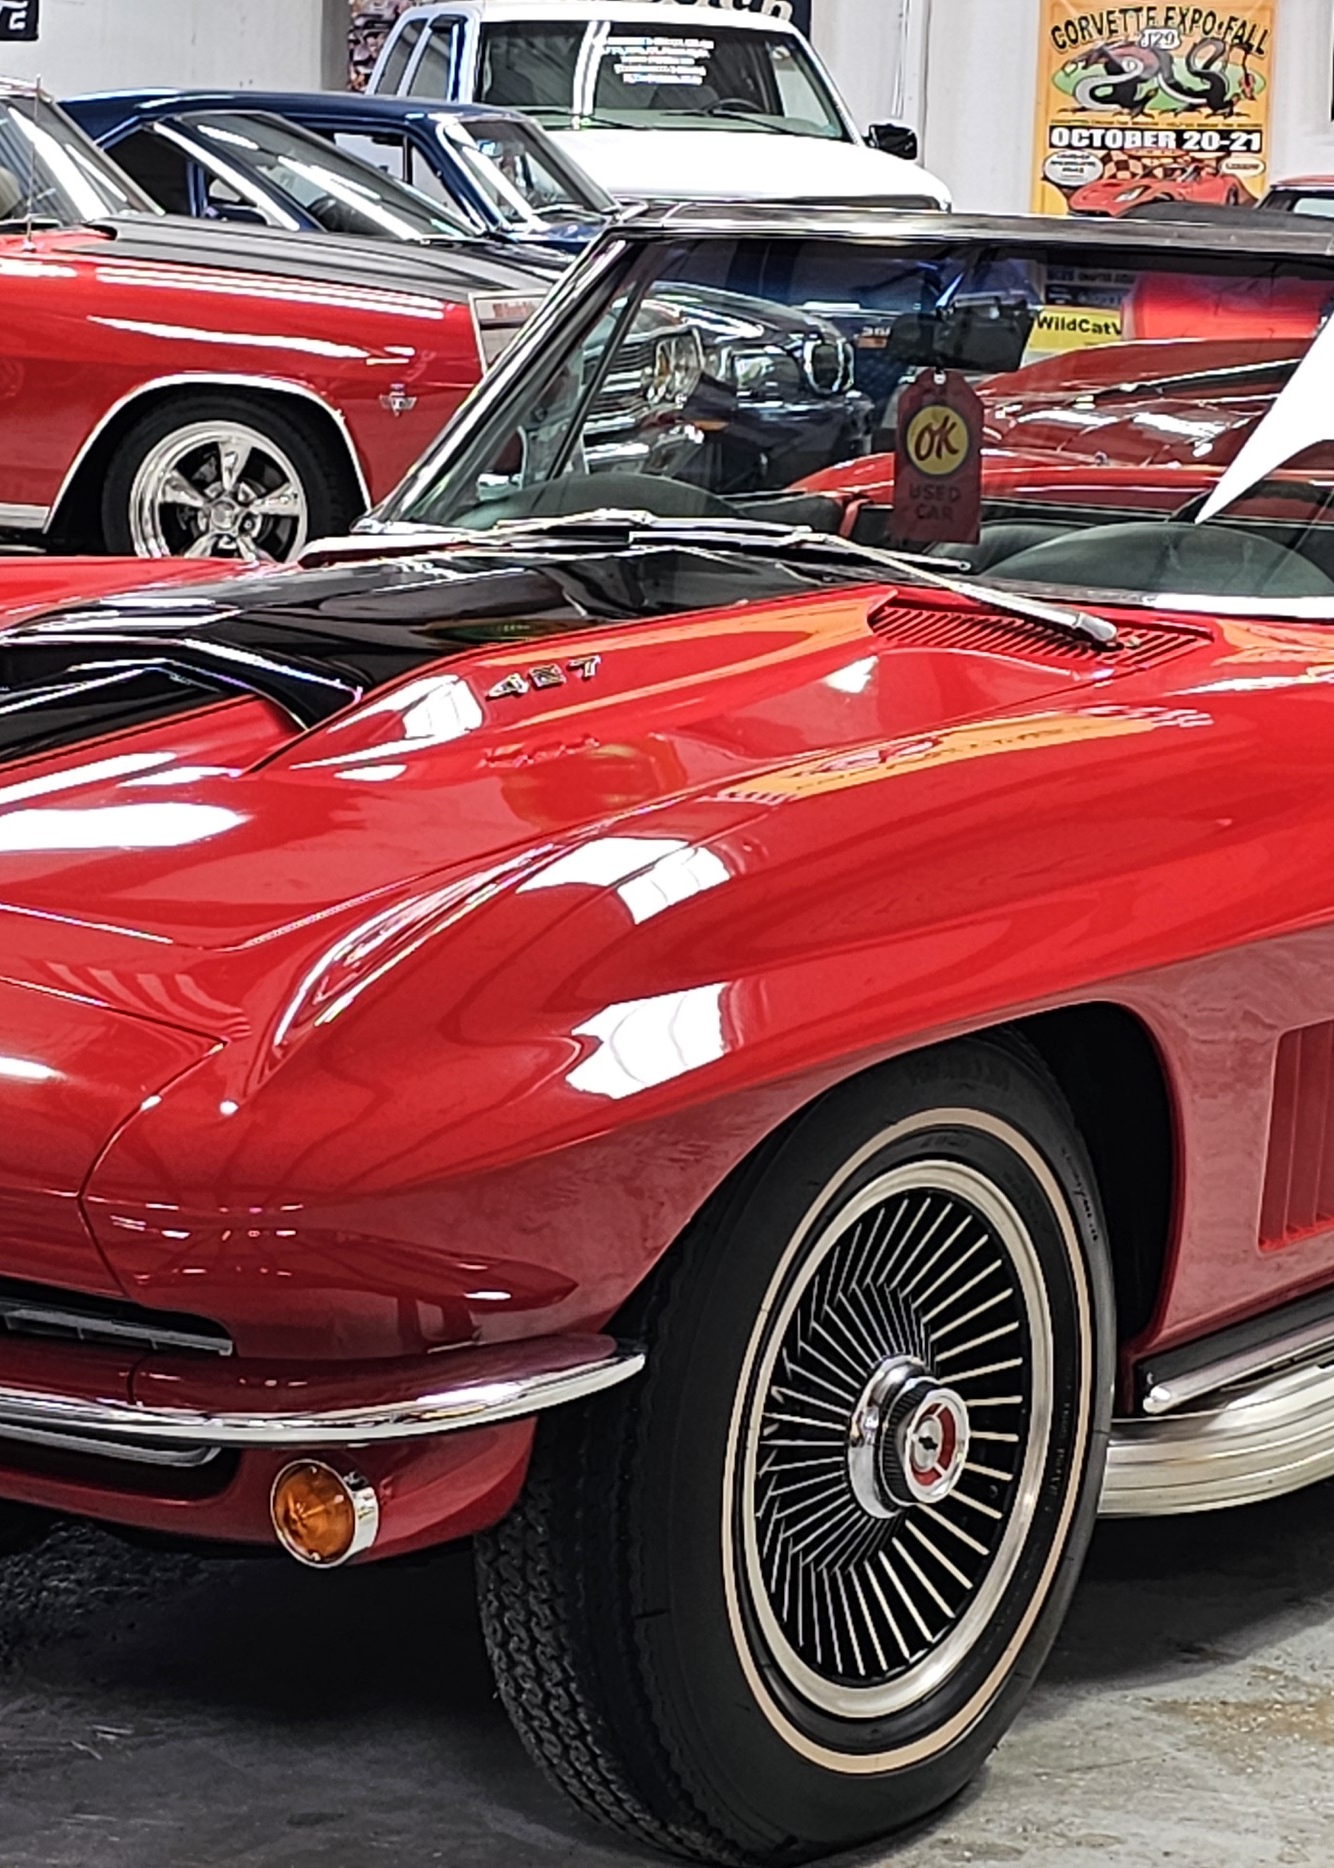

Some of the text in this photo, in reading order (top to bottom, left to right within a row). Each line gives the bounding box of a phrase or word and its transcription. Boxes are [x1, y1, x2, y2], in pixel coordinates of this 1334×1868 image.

[1051, 7, 1157, 49] CORVETTE
[1051, 127, 1262, 151] OCTOBER 20-21
[914, 415, 959, 461] OK
[909, 484, 962, 501] USED
[917, 506, 954, 520] CAR
[487, 654, 602, 699] 427
